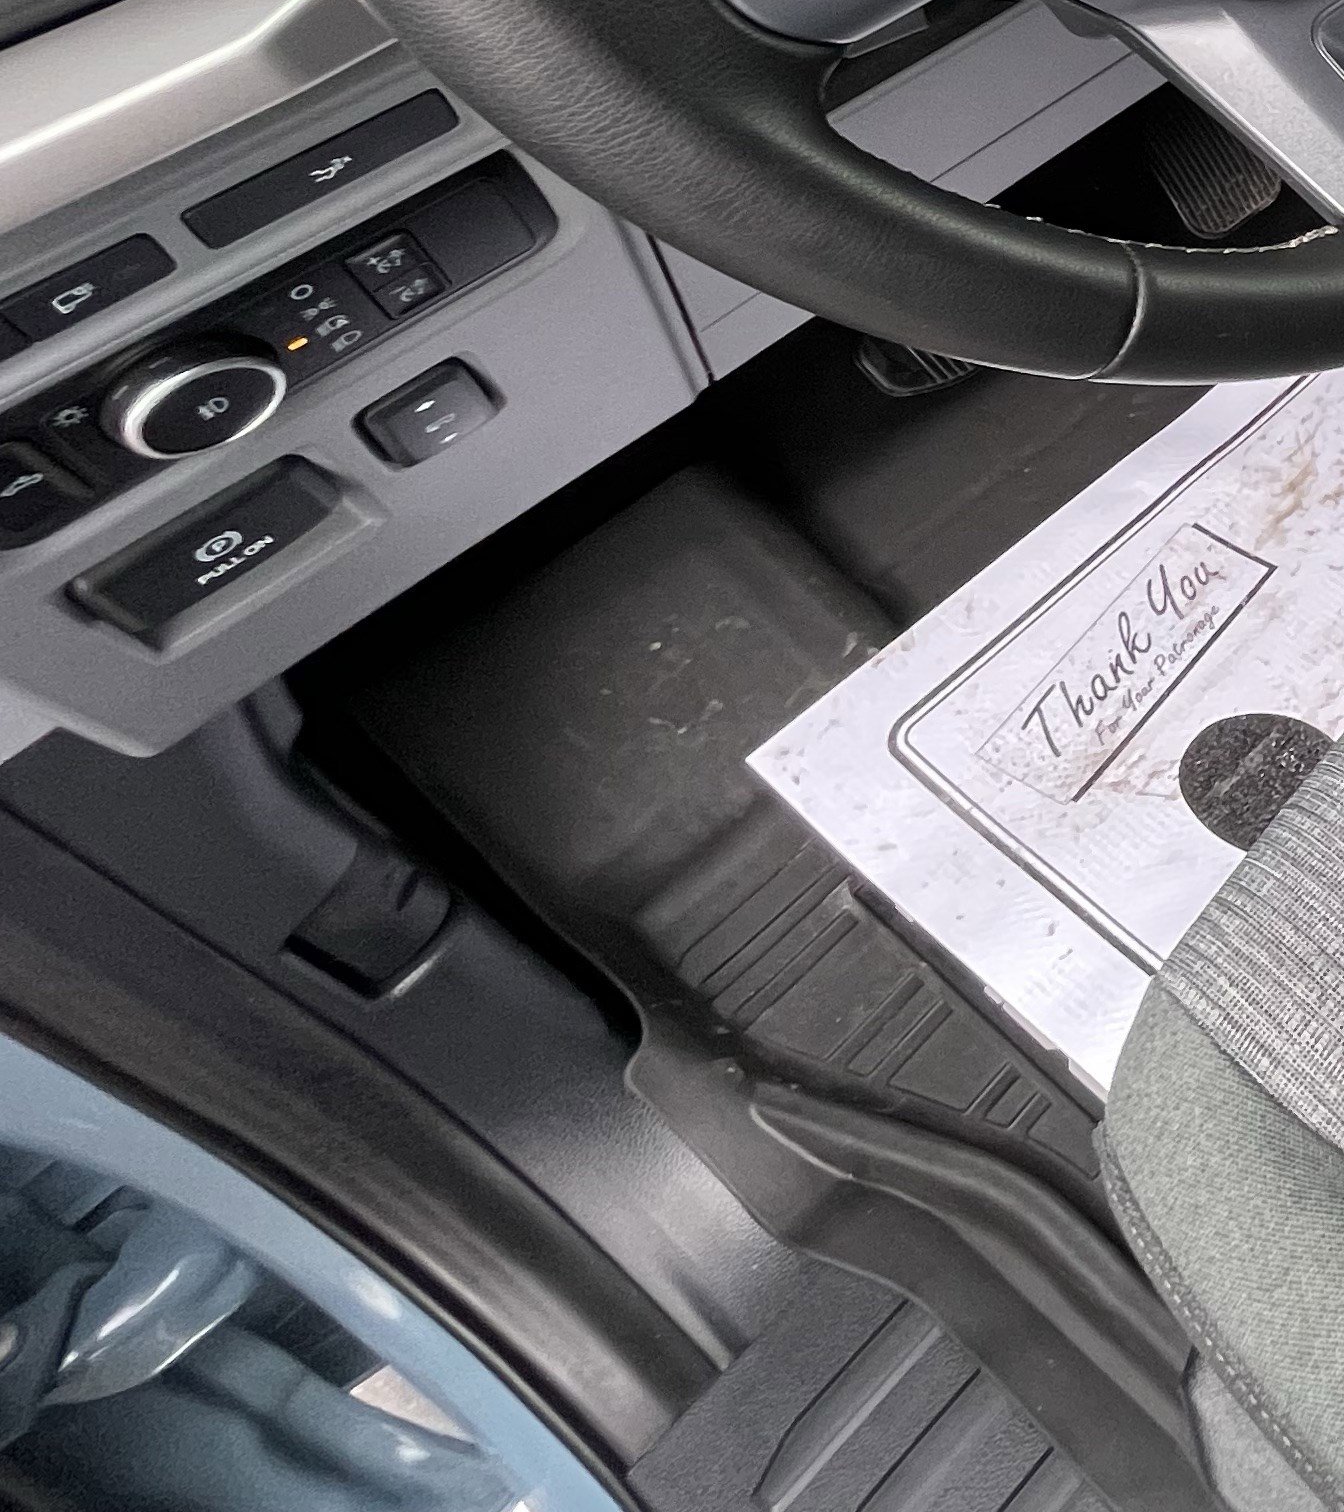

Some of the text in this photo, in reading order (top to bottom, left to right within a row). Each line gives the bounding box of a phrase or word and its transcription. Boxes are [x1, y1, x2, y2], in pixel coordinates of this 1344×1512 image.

[197, 535, 274, 585] PULL ON
[1021, 562, 1219, 758] Thank You
[1095, 605, 1221, 746] For Your Patronage
